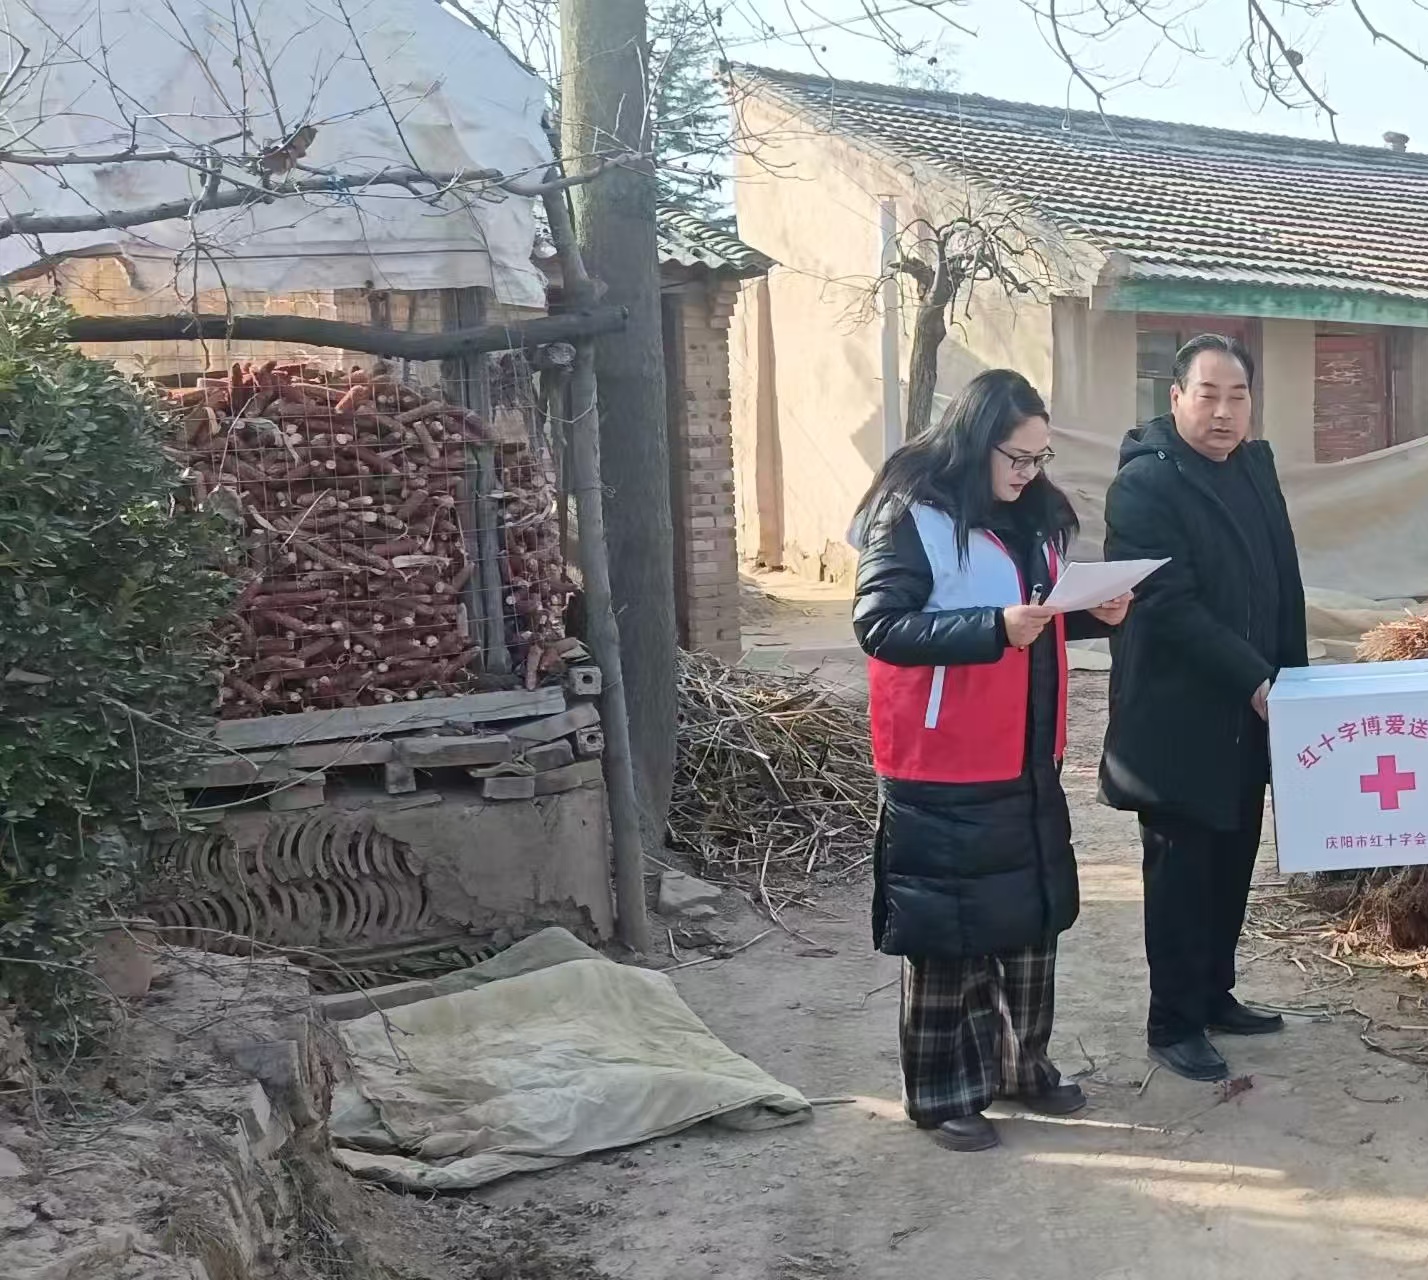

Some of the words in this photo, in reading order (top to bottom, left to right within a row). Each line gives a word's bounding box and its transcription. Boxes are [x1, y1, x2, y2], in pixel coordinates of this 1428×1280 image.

[1325, 832, 1427, 850] 庆阳市红十字会
